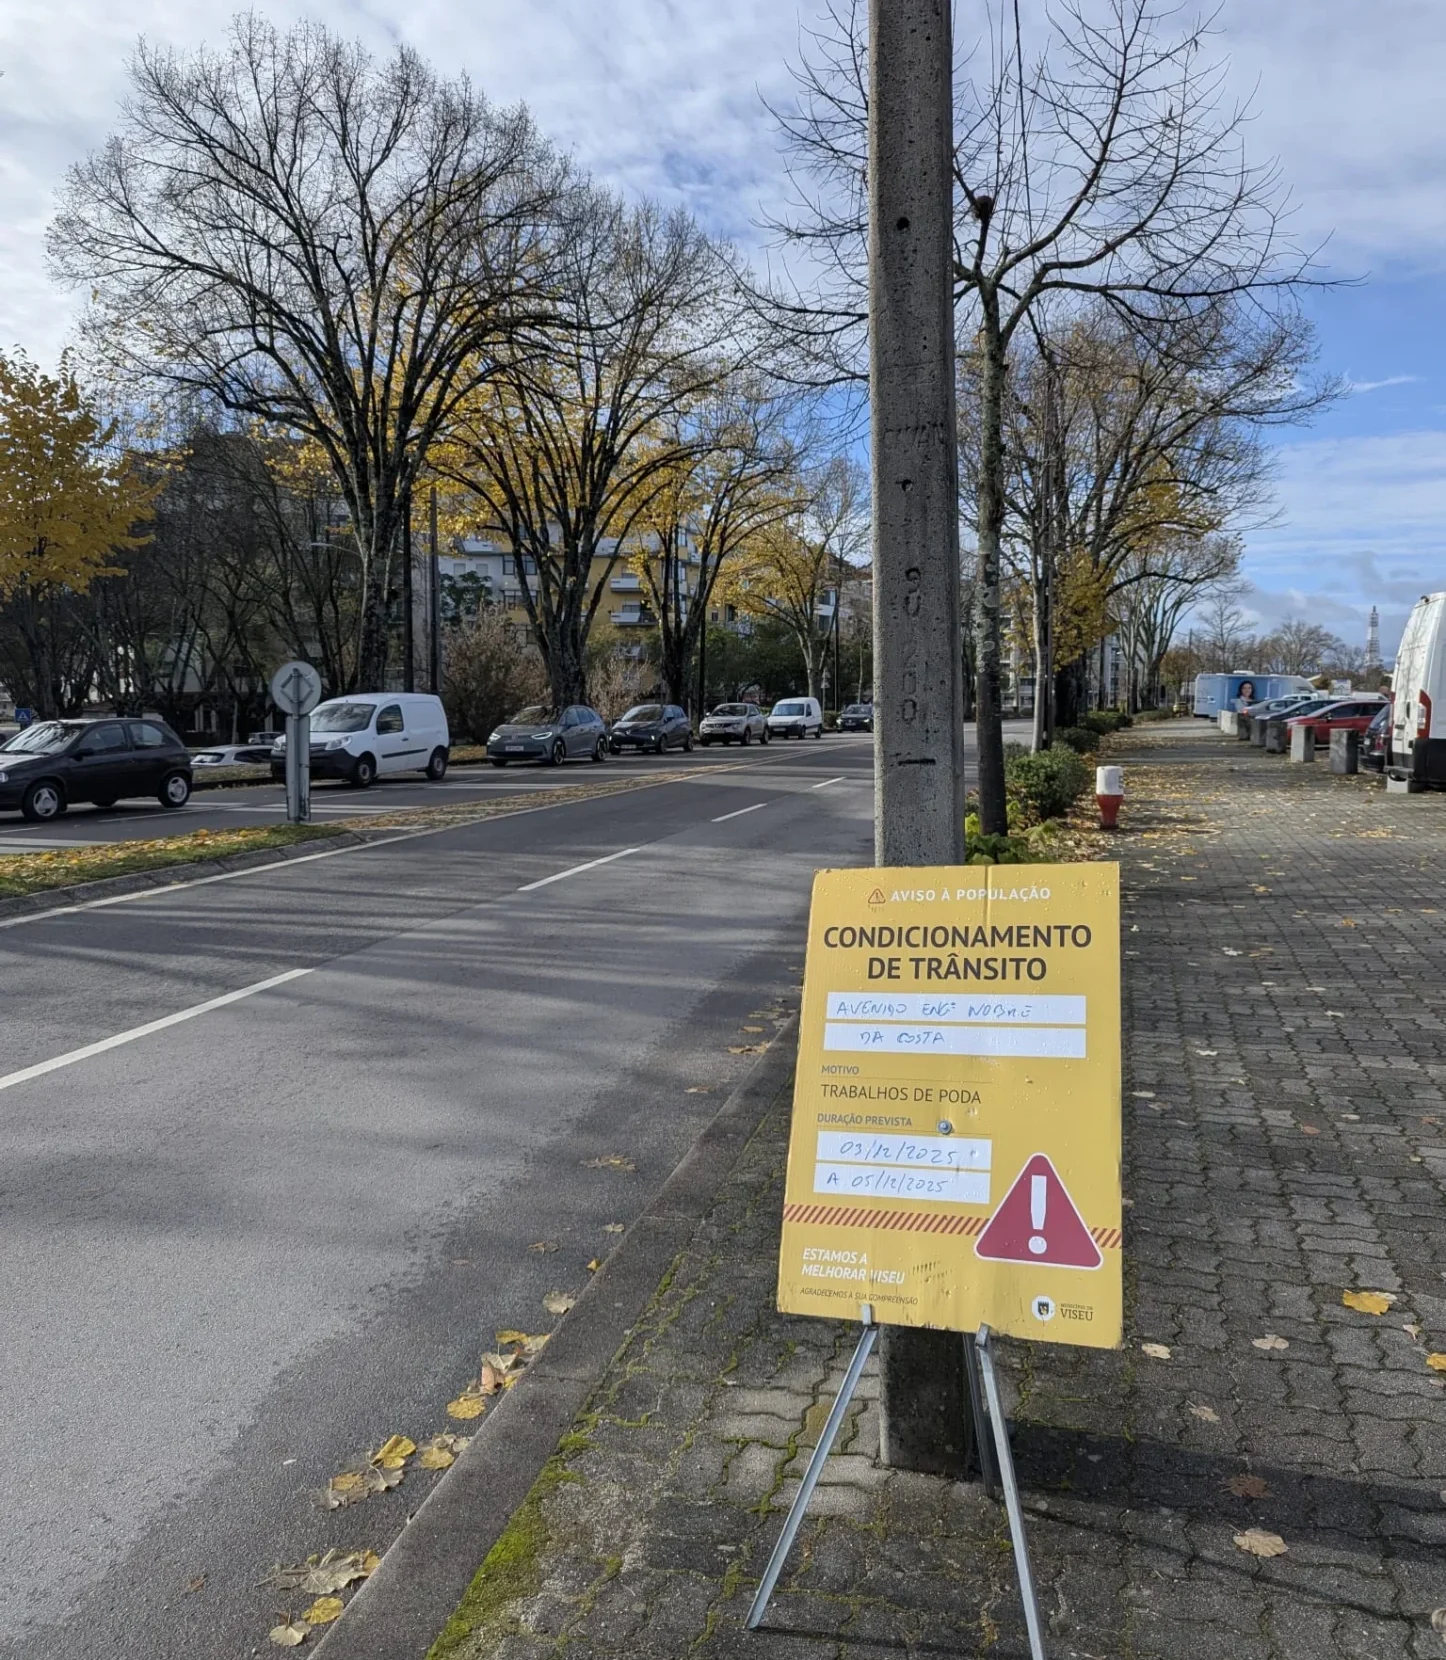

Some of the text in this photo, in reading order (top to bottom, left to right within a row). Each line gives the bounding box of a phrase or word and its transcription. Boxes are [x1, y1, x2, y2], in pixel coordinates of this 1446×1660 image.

[890, 886, 1051, 903] AVISO À POPULAÇÃO
[823, 924, 1092, 949] CONDICIONAMENTO
[867, 952, 1047, 981] DE TRÂNSITO
[896, 1031, 945, 1044] COSTA
[821, 1064, 859, 1075] MOTIVO
[821, 1083, 981, 1104] TRABALHOS DE PODA
[817, 1112, 913, 1127] DURAÇÃO PREVISTA
[840, 1139, 958, 1165] 03/12/2025
[826, 1170, 949, 1193] A 05/12/2025
[803, 1248, 868, 1265] ESTAMOS A
[802, 1264, 906, 1285] MELHORAR VISEU
[800, 1287, 848, 1299] AGRADECEMOS
[855, 1291, 868, 1301] SUA
[1060, 1308, 1094, 1322] VISEU
